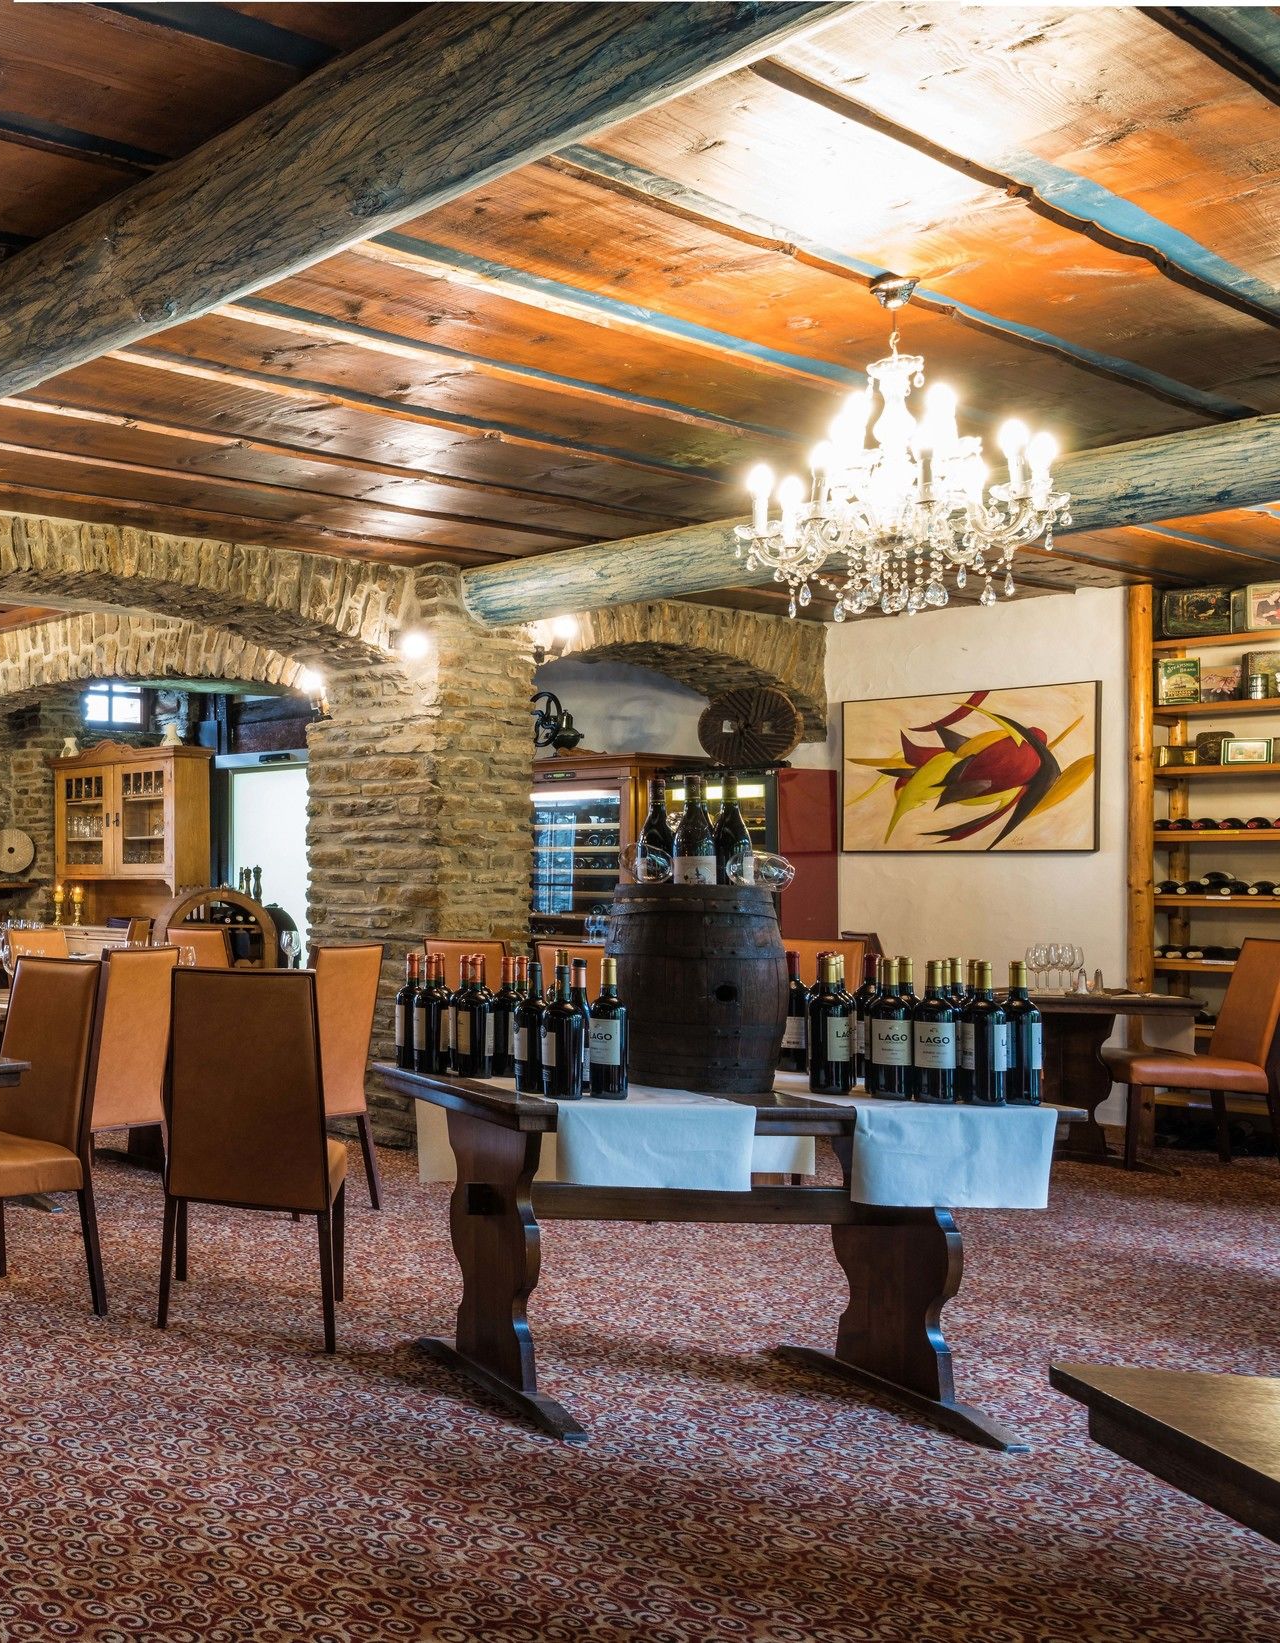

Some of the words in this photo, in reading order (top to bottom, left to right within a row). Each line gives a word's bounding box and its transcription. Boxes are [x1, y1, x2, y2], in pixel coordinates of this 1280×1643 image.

[589, 1033, 612, 1041] AGO
[878, 1033, 908, 1041] LAGO
[919, 1036, 950, 1044] LAGO
